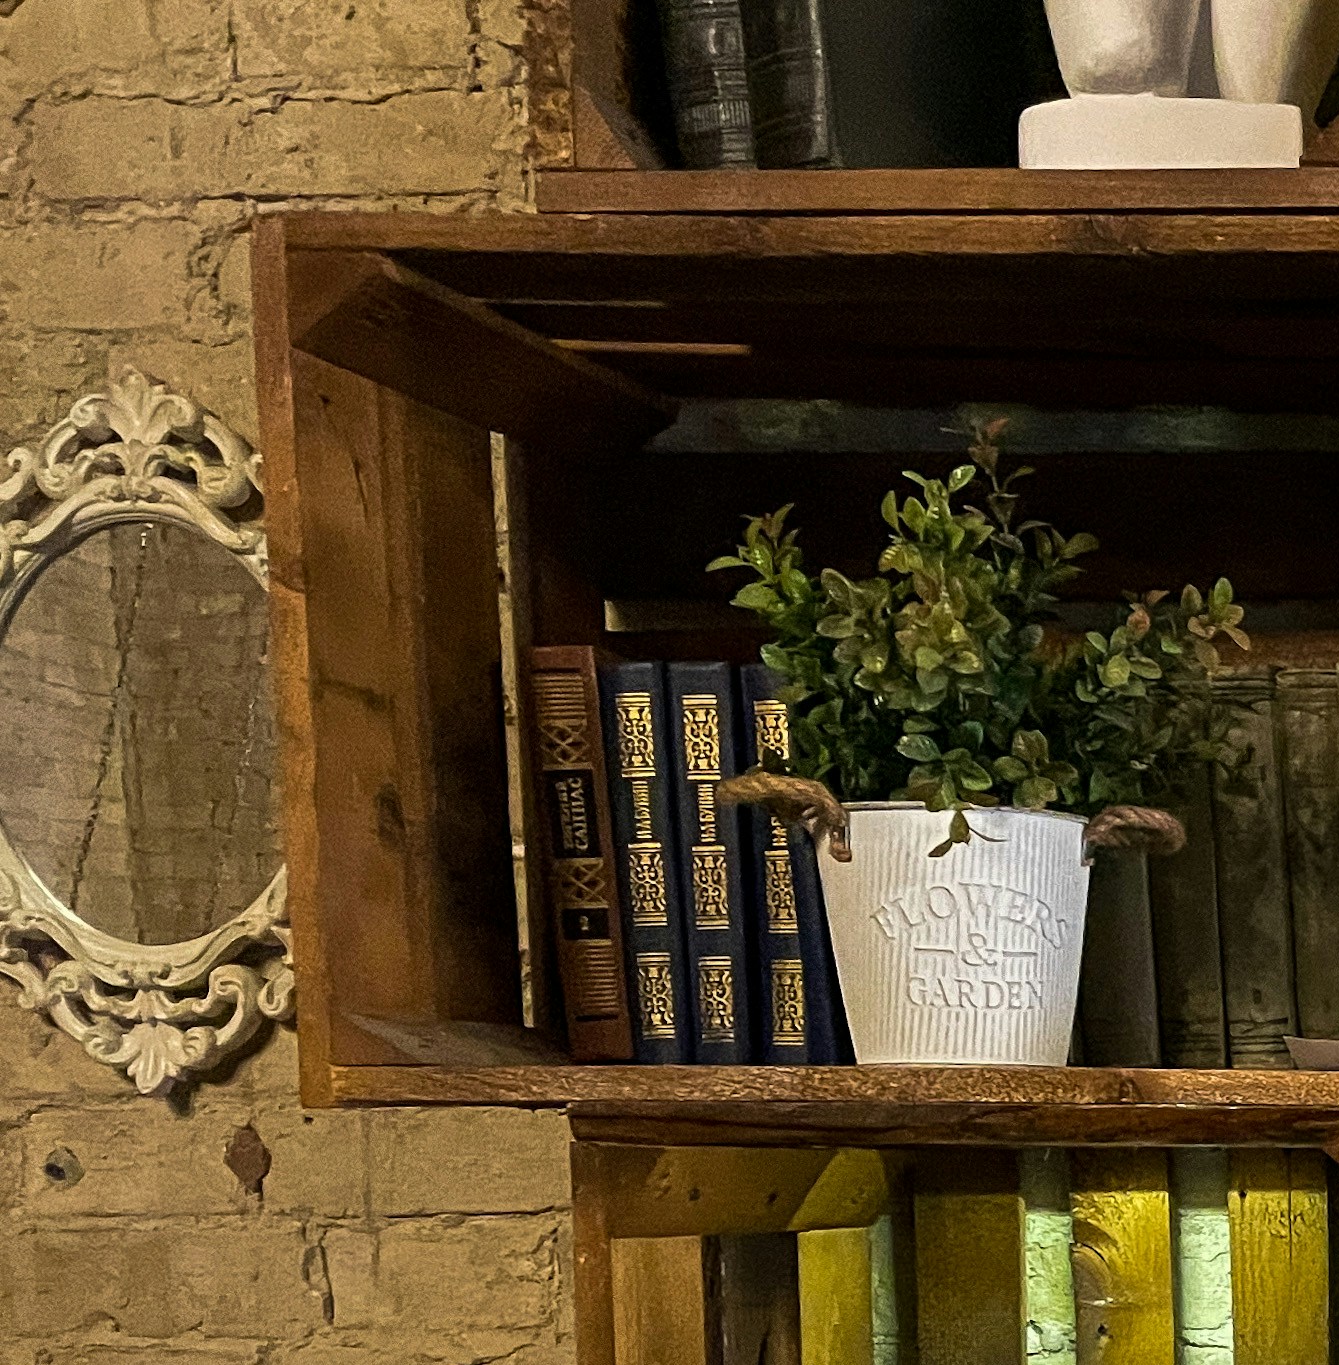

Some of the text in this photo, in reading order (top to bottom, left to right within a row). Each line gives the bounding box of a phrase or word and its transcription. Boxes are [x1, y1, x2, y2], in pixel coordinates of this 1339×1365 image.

[870, 881, 1069, 950] FLOWERS
[961, 932, 997, 968] &
[907, 976, 1044, 1011] GARDEN
